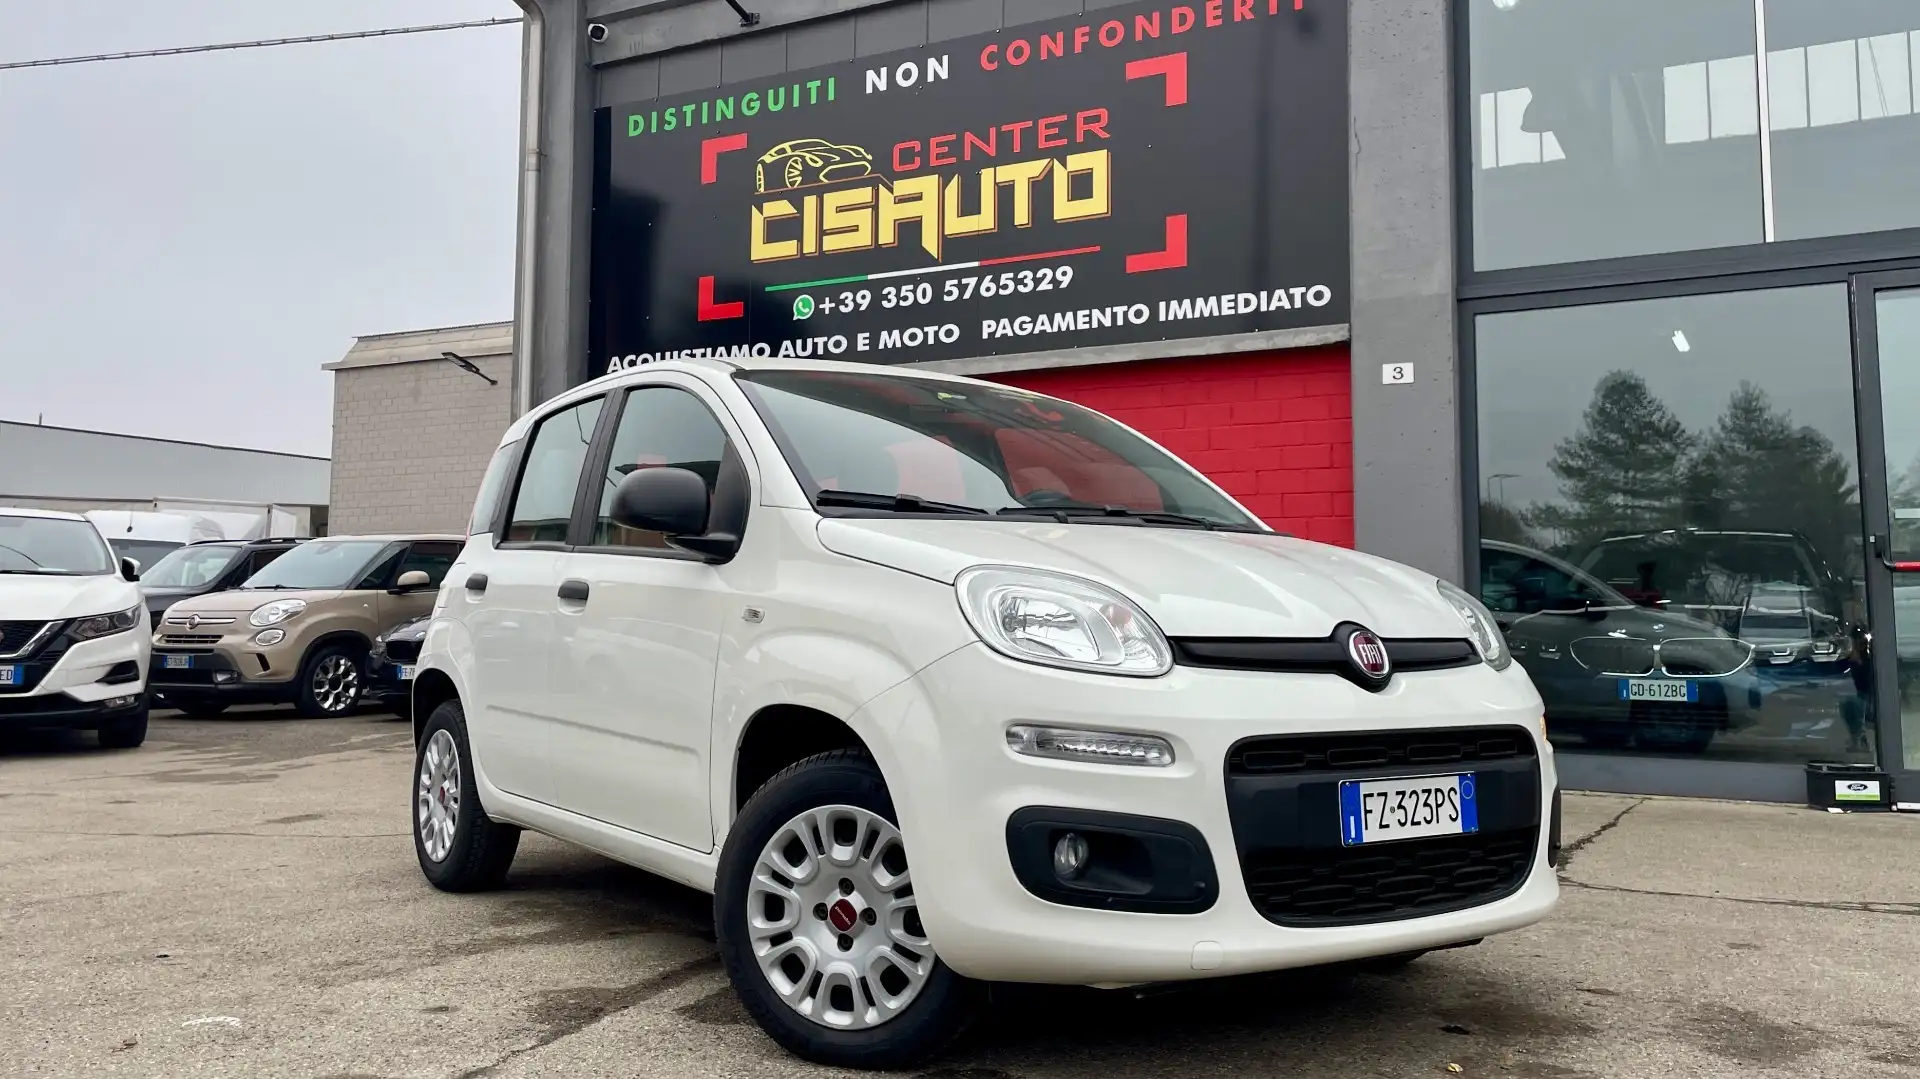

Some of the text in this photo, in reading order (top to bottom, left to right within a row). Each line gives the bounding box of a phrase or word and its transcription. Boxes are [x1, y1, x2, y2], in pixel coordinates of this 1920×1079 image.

[627, 76, 837, 138] DISTINGUITI
[865, 54, 950, 95] NON
[892, 107, 1111, 172] CENTER
[750, 149, 1112, 262] CISAUTO
[777, 334, 848, 359] AUTO
[857, 332, 870, 351] E
[878, 323, 960, 350] MOTO
[982, 303, 1150, 340] PAGAMENTO
[1158, 284, 1332, 322] IMMEDIATO
[818, 265, 1074, 316] +39 350 5765329
[1392, 366, 1404, 380] 3
[1358, 643, 1383, 665] FIAT
